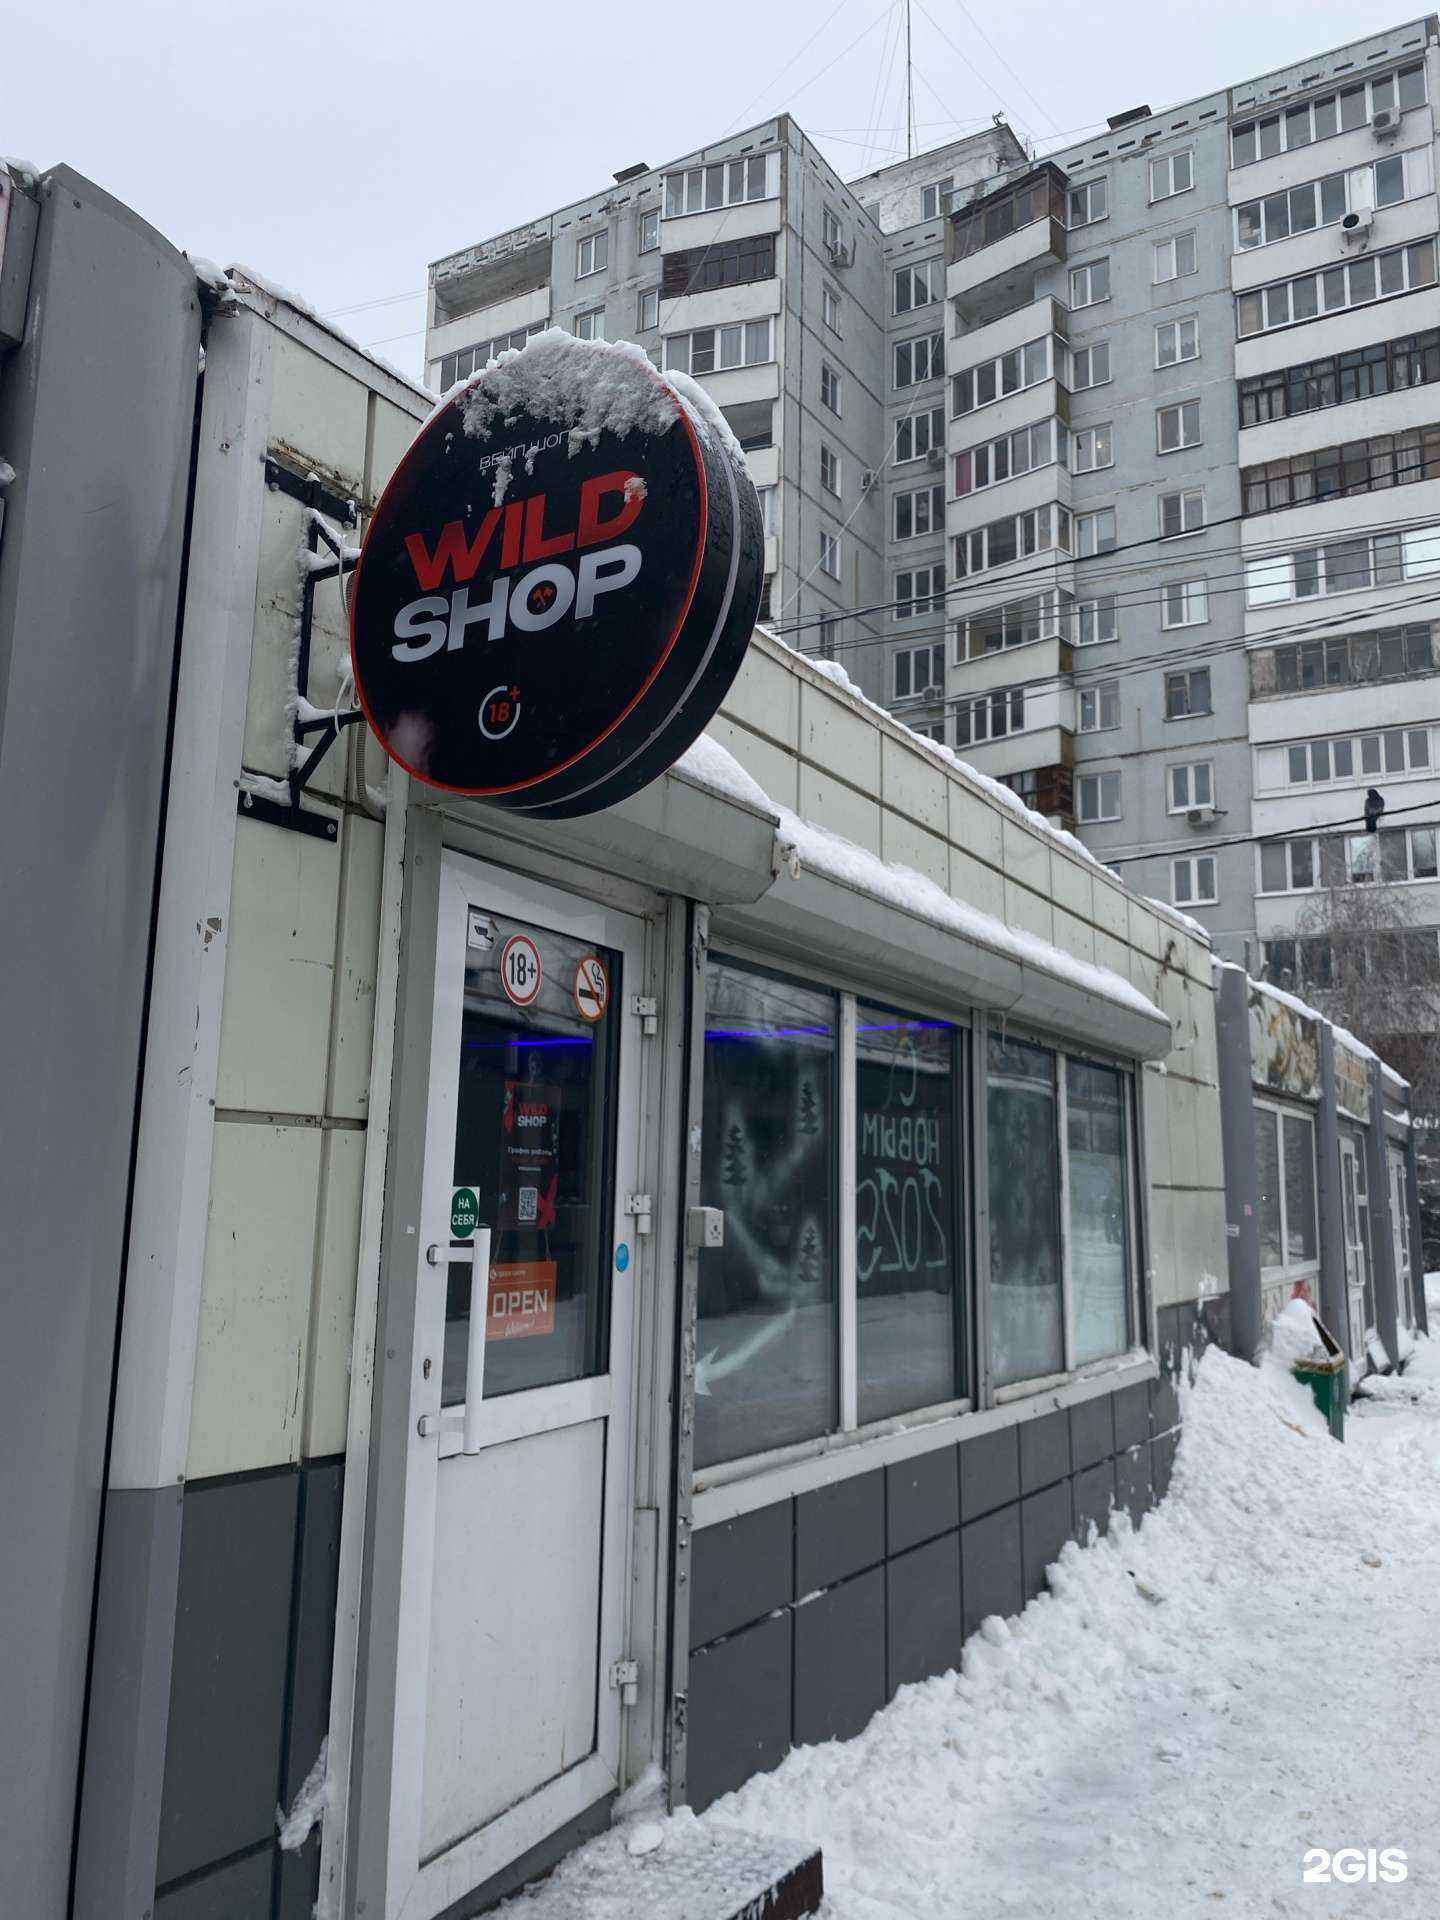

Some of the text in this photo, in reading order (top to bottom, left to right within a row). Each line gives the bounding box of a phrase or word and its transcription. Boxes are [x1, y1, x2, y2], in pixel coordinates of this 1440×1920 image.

[404, 470, 647, 591] WILD
[392, 544, 642, 663] SHOP
[508, 951, 537, 987] 18+
[517, 1115, 548, 1128] SHOP
[458, 1198, 470, 1209] НА
[452, 1214, 475, 1226] СЕБЯ
[492, 1289, 548, 1318] OPEN
